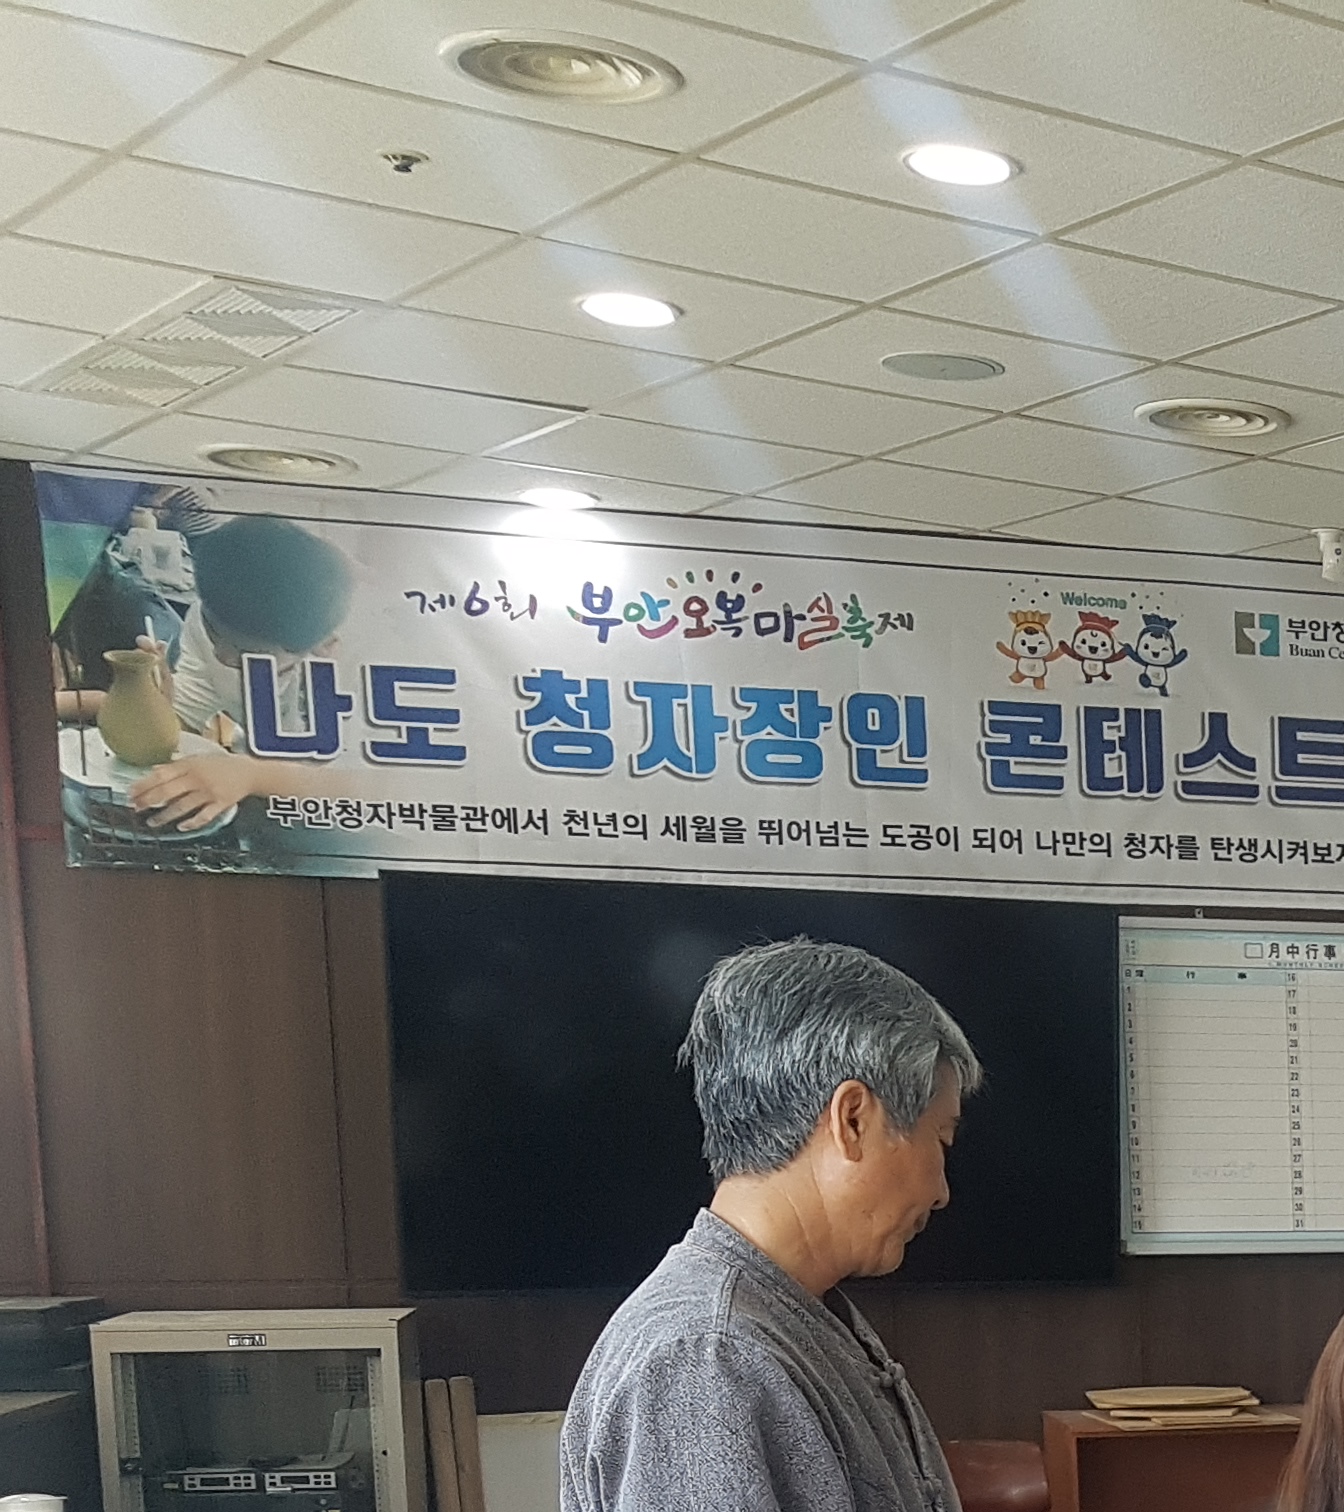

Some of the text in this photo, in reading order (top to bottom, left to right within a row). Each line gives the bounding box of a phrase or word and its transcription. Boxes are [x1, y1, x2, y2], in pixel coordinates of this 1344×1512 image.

[403, 581, 539, 622] 제6회
[1060, 591, 1128, 611] Welcome
[1289, 644, 1324, 661] Buan
[241, 653, 468, 768] 나도
[517, 667, 931, 793] 청자장인
[266, 796, 550, 836] 부안청자박물관에서
[561, 808, 648, 842] 천년의
[660, 812, 748, 846] 세월을
[757, 815, 869, 850] 뛰어넘는
[879, 824, 961, 854] 도공이
[970, 827, 1024, 857] 되어
[1035, 830, 1113, 859] 나만의
[1124, 831, 1200, 862] 청자를
[1288, 973, 1295, 981] 16
[1288, 990, 1296, 998] 17
